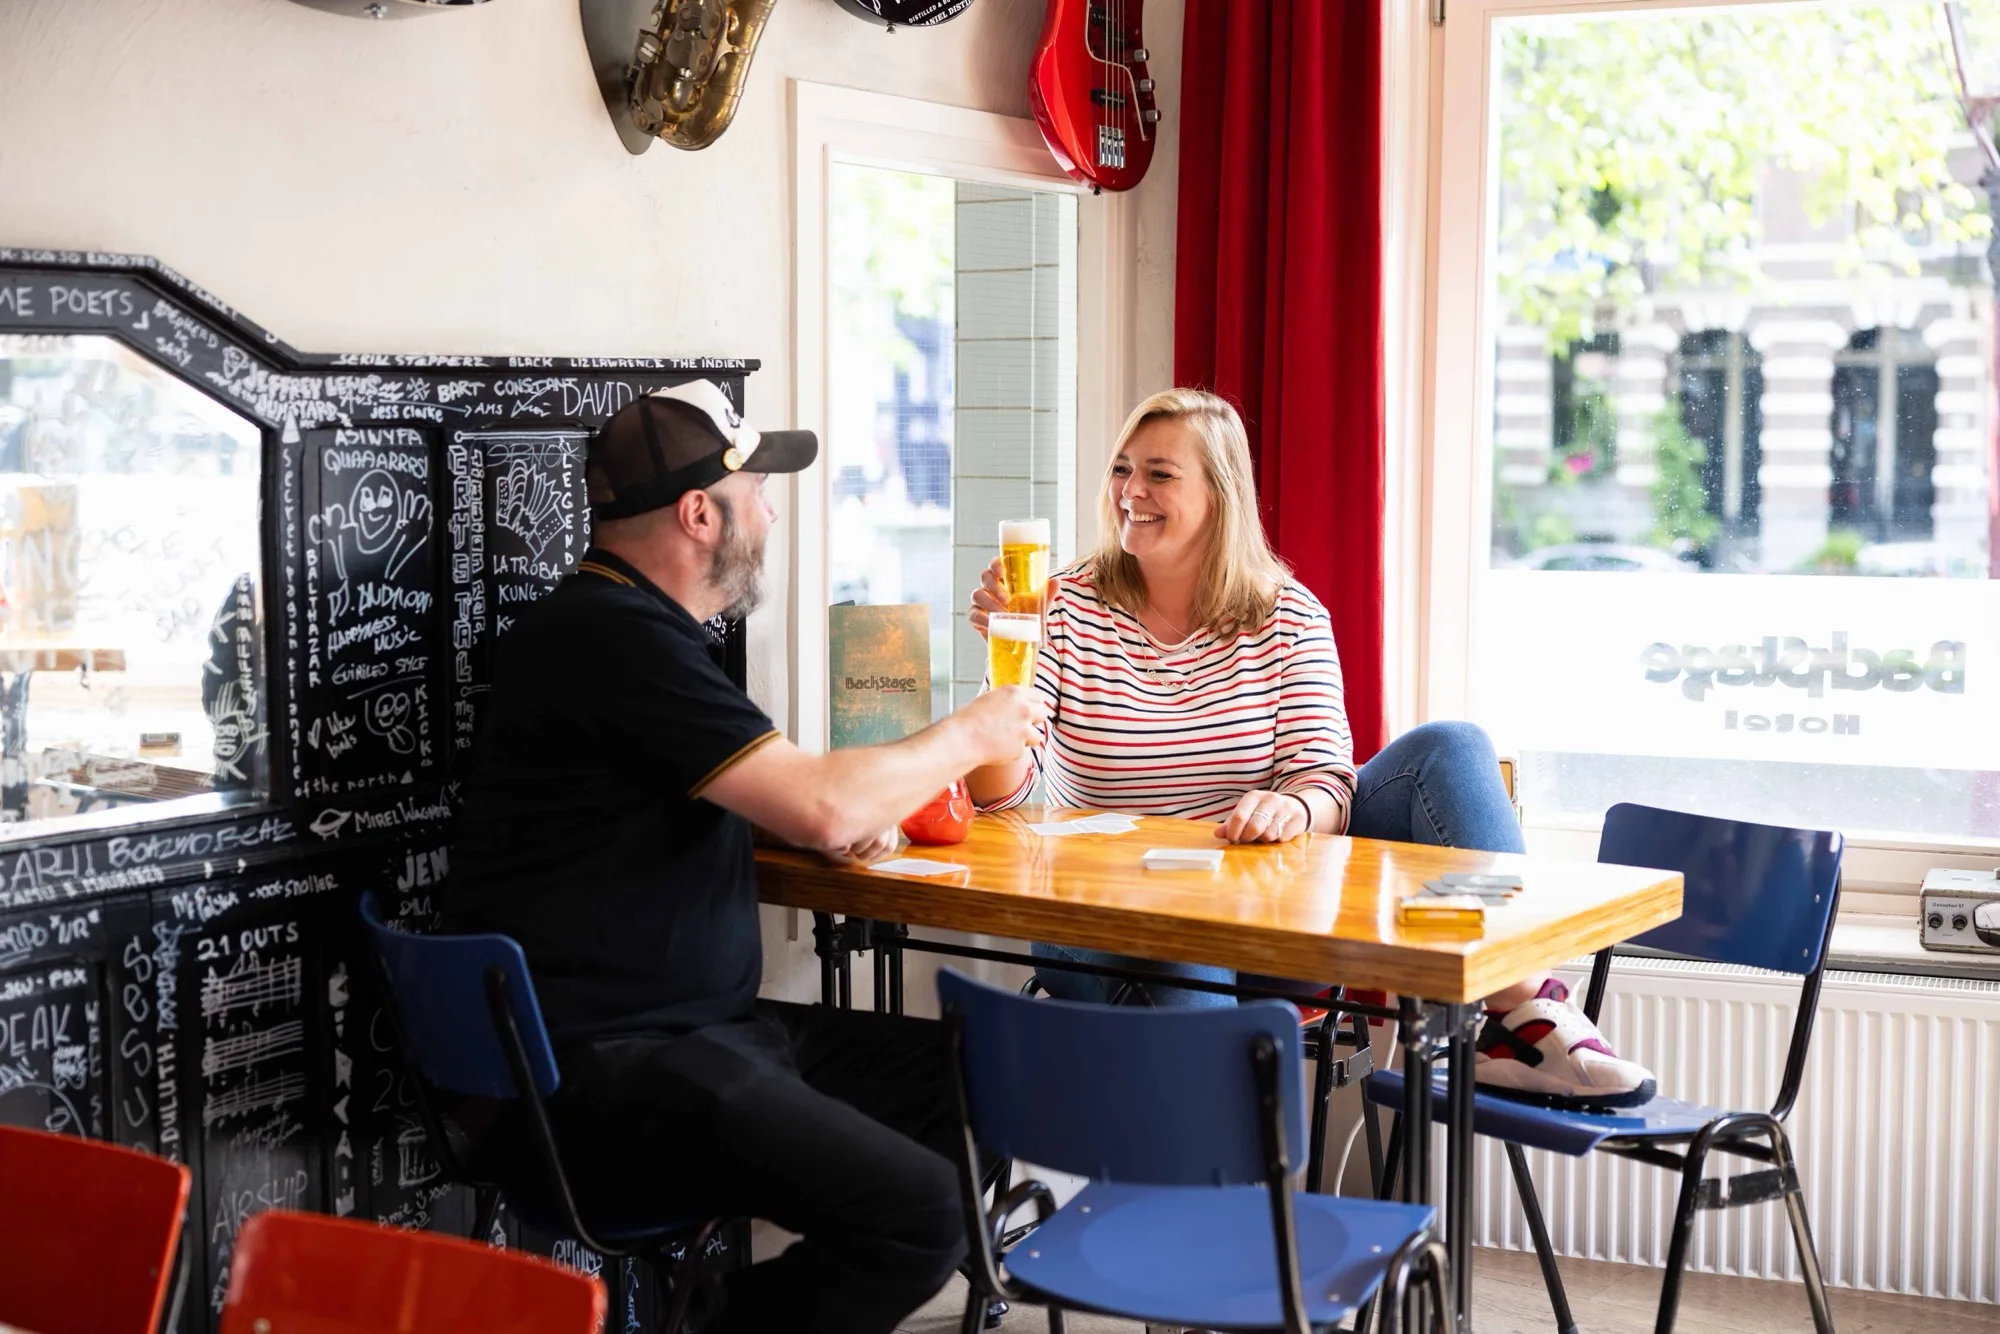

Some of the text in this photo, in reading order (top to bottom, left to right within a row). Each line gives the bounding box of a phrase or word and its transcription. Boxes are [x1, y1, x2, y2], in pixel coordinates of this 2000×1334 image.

[908, 6, 936, 23] DISTILLED
[48, 285, 134, 318] POETS
[509, 356, 553, 368] BLACK
[672, 358, 747, 369] THE INDIEN
[241, 362, 323, 403] JEFFREY
[437, 376, 579, 403] BART CONSTANT
[562, 380, 634, 418] DAVID
[560, 452, 575, 567] LEGEND
[304, 550, 322, 689] BALTHAZAR
[347, 773, 398, 790] north
[354, 808, 400, 833] MIREL
[197, 921, 300, 961] 21 OUTS
